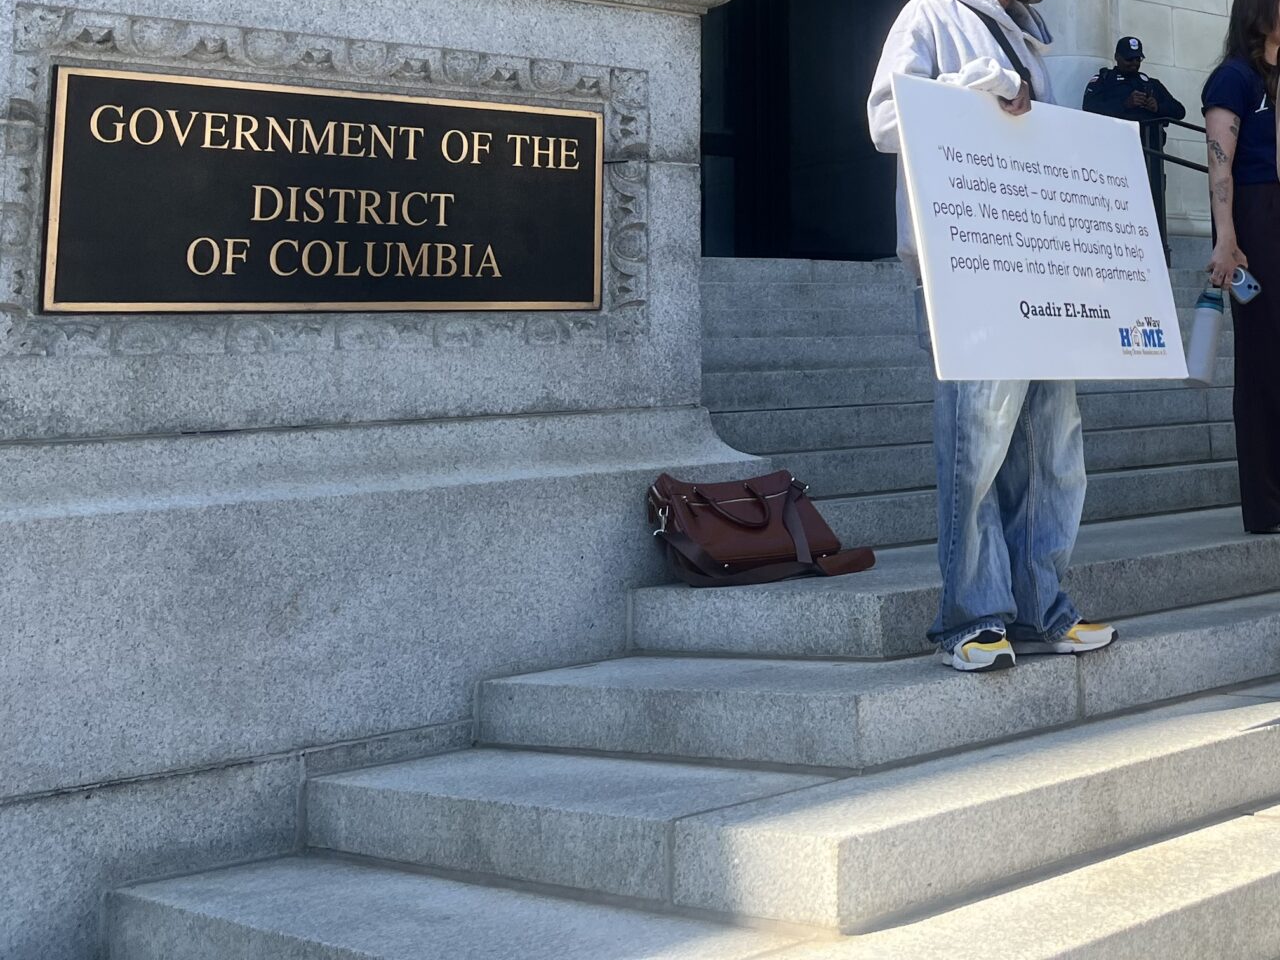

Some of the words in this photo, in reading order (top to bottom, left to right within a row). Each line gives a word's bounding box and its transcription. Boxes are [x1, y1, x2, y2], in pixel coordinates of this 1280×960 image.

[89, 103, 425, 161] GOVERNMENT
[441, 129, 494, 165] OF
[507, 134, 581, 171] THE
[966, 152, 995, 168] need
[997, 154, 1008, 170] to
[1009, 156, 1042, 175] invest
[1043, 164, 1069, 179] more
[1070, 166, 1080, 181] in
[1107, 174, 1130, 188] most
[250, 184, 456, 228] DISTRICT
[948, 174, 997, 194] valuable
[999, 182, 1030, 198] asset
[1040, 188, 1057, 201] our
[1059, 191, 1113, 212] community,
[1114, 199, 1129, 212] our
[933, 201, 977, 219] people.
[978, 202, 999, 220] We
[1001, 208, 1029, 223] need
[1030, 210, 1042, 225] to
[1043, 210, 1066, 228] fund
[1068, 215, 1114, 234] programs
[1114, 220, 1137, 235] such
[1138, 225, 1149, 237] as
[186, 236, 251, 277] OF
[269, 239, 503, 280] COLUMBIA
[949, 225, 1014, 247] Permanent
[1015, 231, 1071, 253] Supportive
[1072, 238, 1113, 260] Housing
[1114, 243, 1124, 257] to
[1125, 243, 1145, 261] help
[950, 254, 990, 274] people
[993, 258, 1023, 273] move
[1025, 257, 1046, 275] into
[1047, 260, 1070, 276] their
[1072, 265, 1093, 278] own
[1019, 300, 1062, 320] Qaadir
[1063, 302, 1111, 319] El-Amin
[1144, 316, 1160, 329] Way
